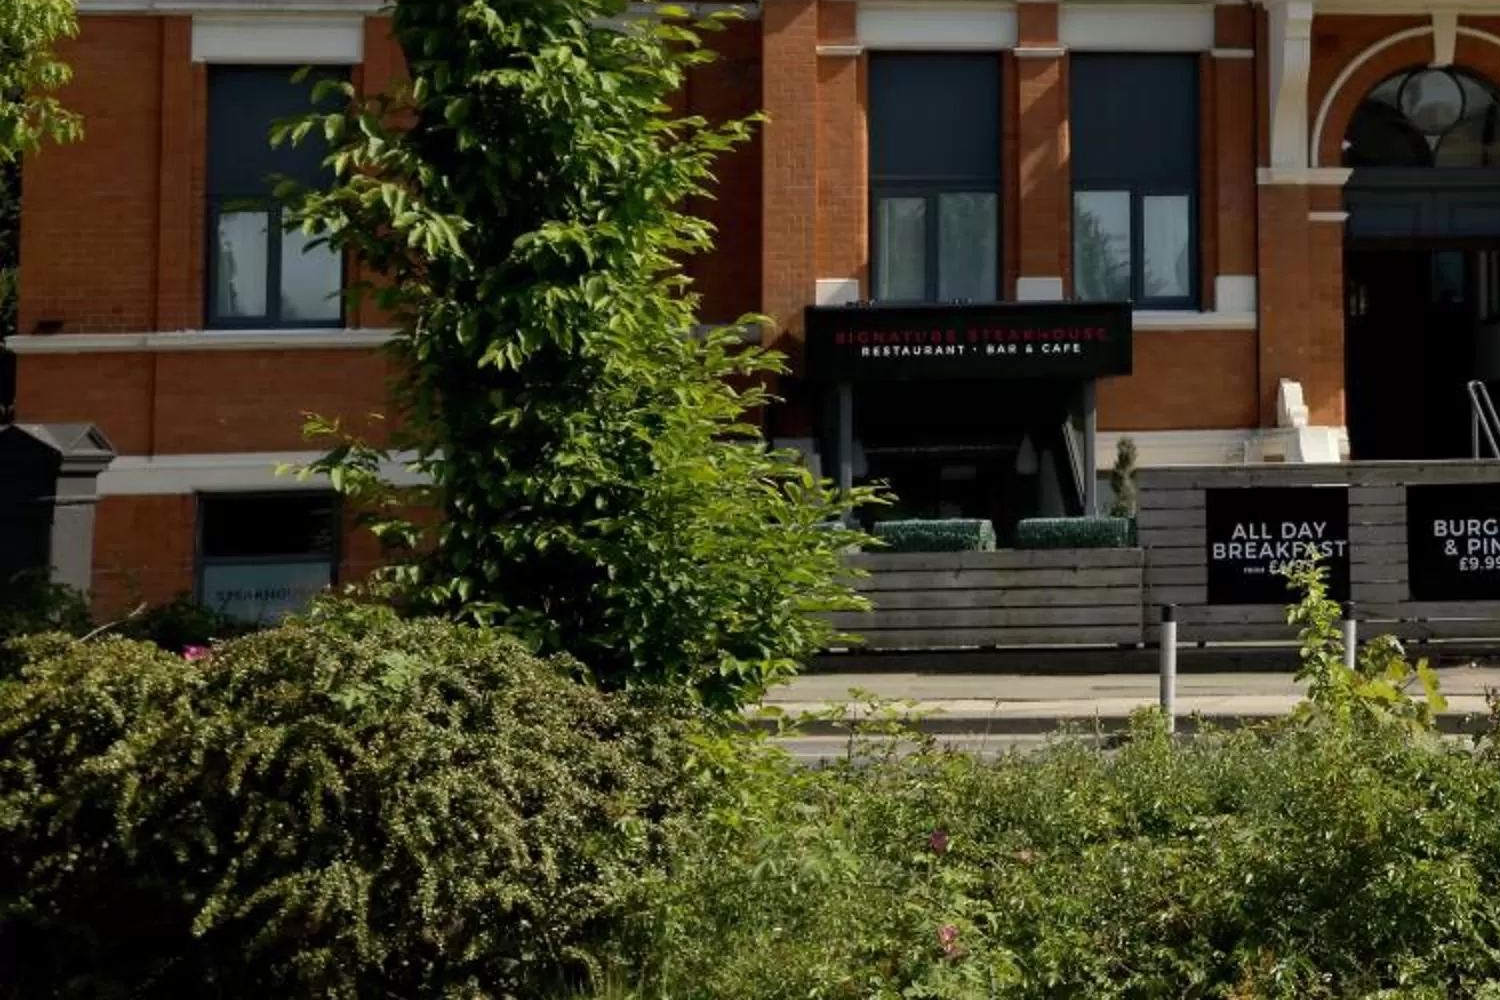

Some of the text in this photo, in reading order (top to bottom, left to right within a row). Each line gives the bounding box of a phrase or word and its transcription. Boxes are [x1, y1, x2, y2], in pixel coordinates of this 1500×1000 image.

[861, 343, 1082, 357] RESTAURANT BAR & CAFE
[1231, 521, 1327, 540] ALL DAY
[1212, 540, 1348, 560] BREAKFAST
[1444, 539, 1459, 555] &
